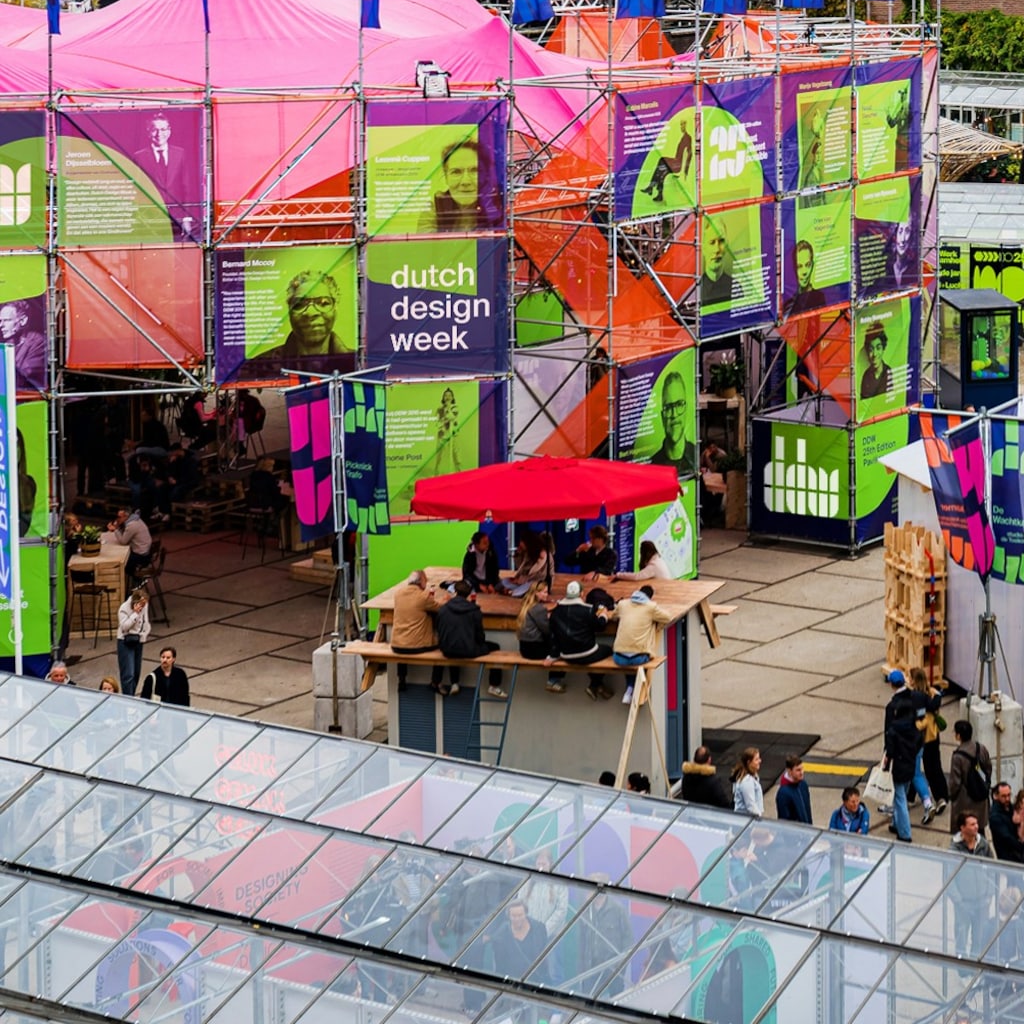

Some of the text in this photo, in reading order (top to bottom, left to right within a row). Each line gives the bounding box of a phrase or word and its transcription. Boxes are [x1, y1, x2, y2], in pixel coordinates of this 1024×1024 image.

[222, 260, 251, 268] Bernard
[391, 263, 475, 289] dutch
[391, 294, 490, 324] design
[390, 327, 469, 352] week
[862, 435, 877, 446] DDW
[877, 440, 897, 454] Edition
[993, 505, 1004, 514] De
[235, 865, 308, 901] DESIGNING
[245, 882, 301, 913] SOCIETY
